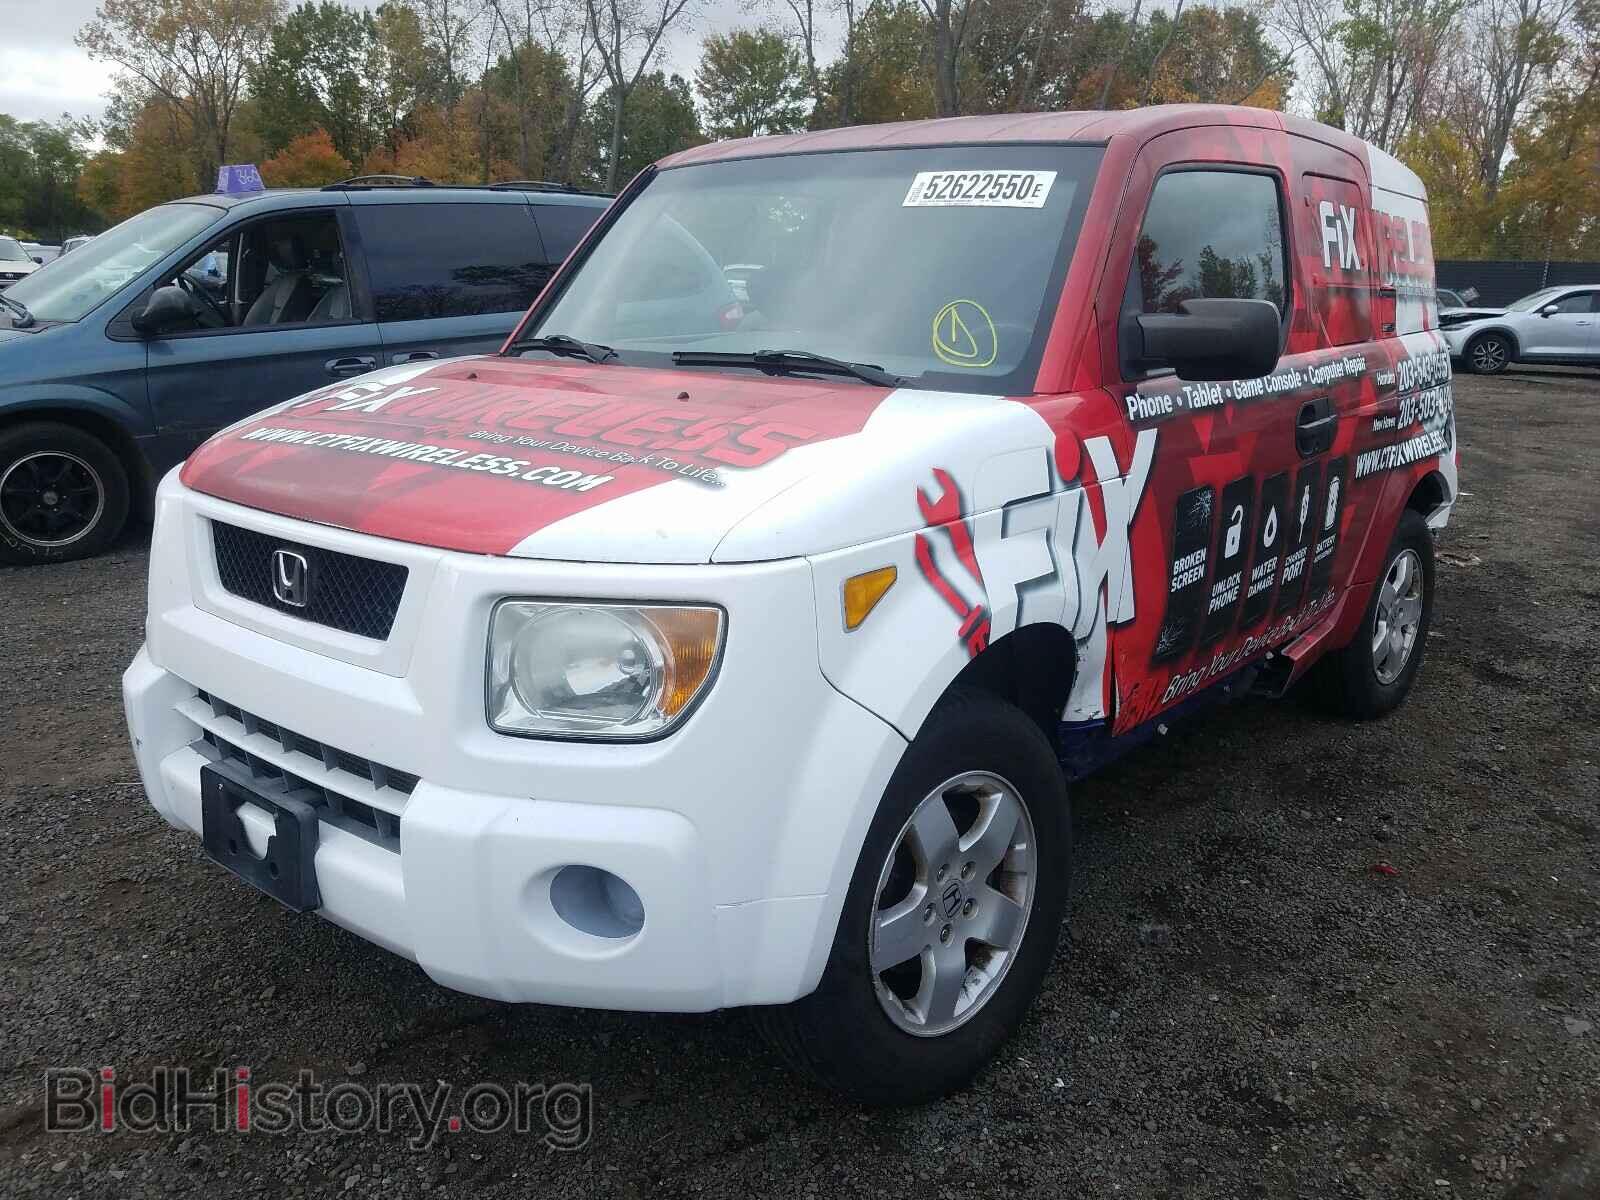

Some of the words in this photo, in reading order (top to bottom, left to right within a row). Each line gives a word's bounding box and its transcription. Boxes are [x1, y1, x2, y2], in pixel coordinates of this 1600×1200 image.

[1125, 393, 1174, 421] Phone
[1182, 382, 1224, 409] Tablet
[1232, 378, 1264, 400] Game
[1265, 370, 1302, 393] Console
[1308, 361, 1345, 385] Computer
[241, 427, 615, 492] WWW.CTFIXWIRELESS.COM
[468, 430, 515, 446] Bring
[512, 435, 546, 451] Your
[547, 440, 610, 461] Device
[655, 455, 679, 471] To
[1173, 547, 1207, 576] BROKEN
[1251, 556, 1278, 583] WATER
[1281, 558, 1306, 586] PORT
[1171, 563, 1205, 593] SCREEN
[1211, 571, 1243, 597] UNLOCK
[1247, 573, 1275, 599] DAMAGE
[1207, 585, 1240, 616] PHONE
